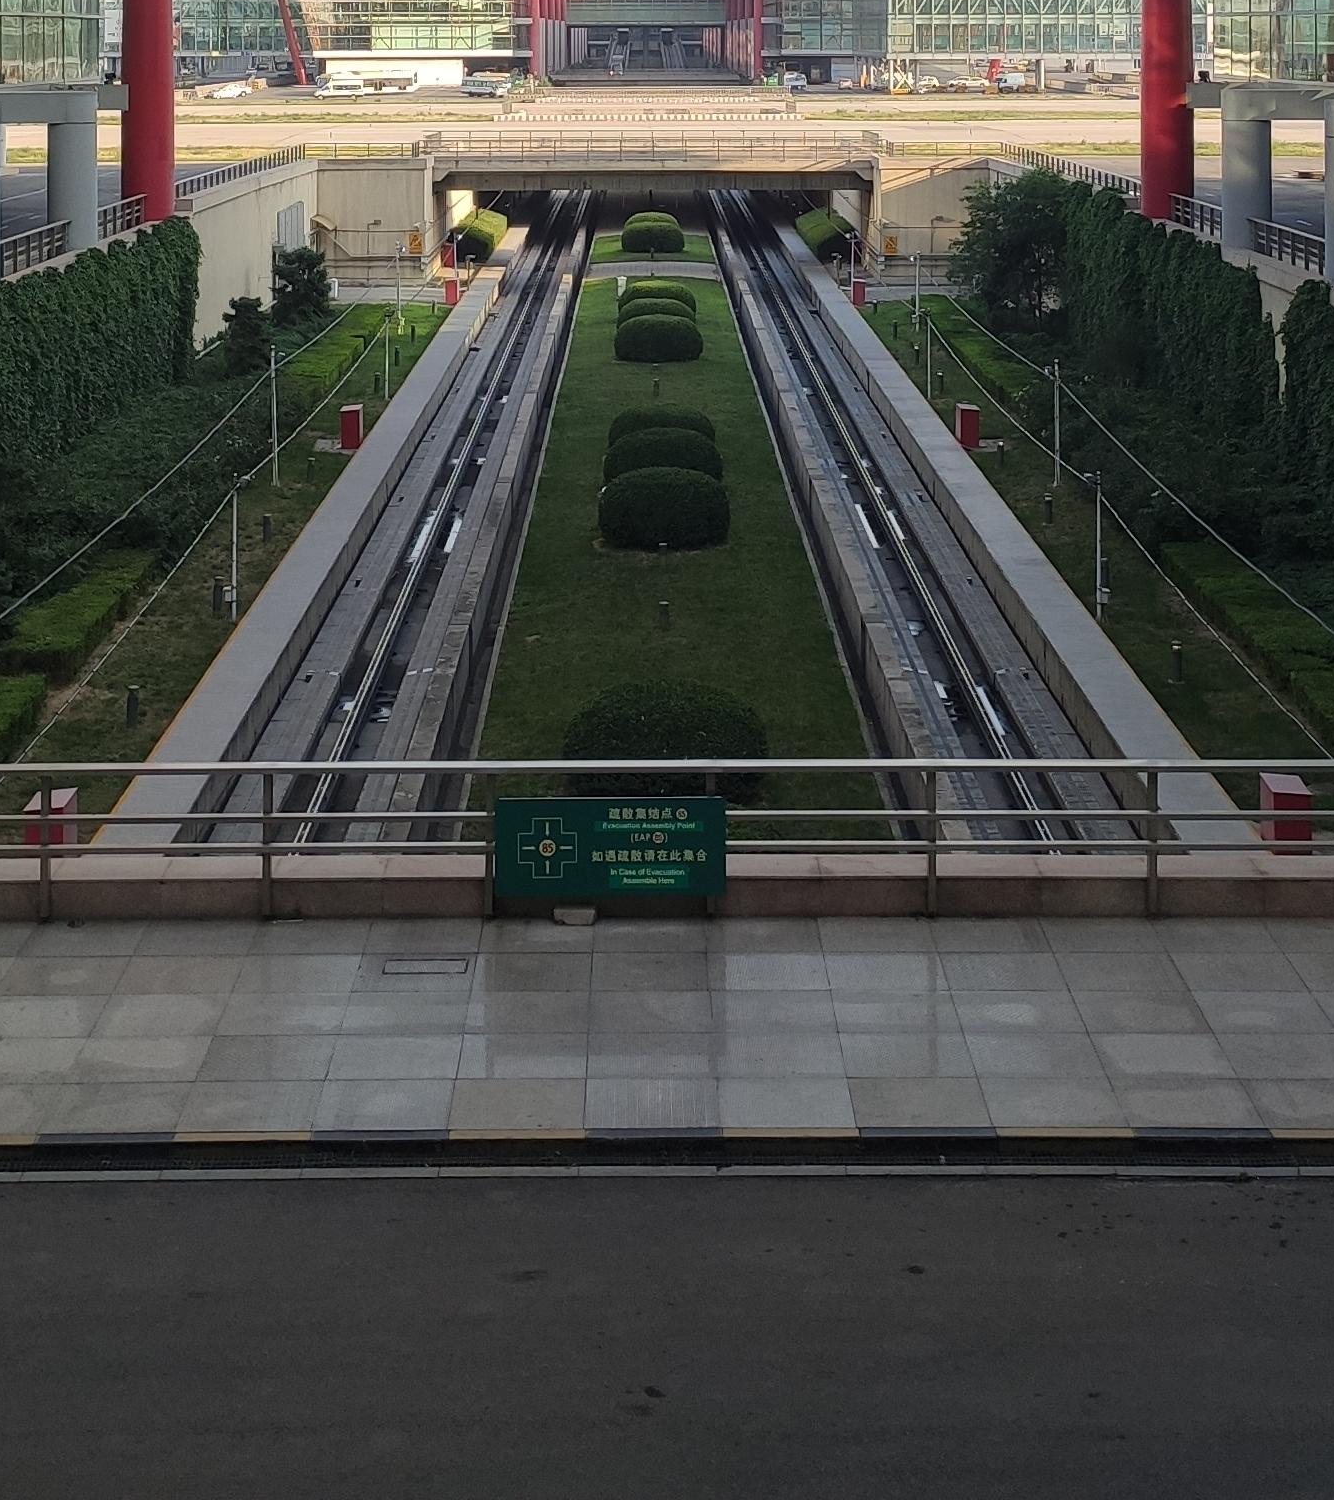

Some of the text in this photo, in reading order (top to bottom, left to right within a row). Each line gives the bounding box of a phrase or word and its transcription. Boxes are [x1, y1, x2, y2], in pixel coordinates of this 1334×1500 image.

[608, 808, 672, 819] 疏散集结点
[641, 822, 675, 831] Assembly
[542, 843, 554, 853] 85
[592, 849, 707, 861] 如遇疏散请在此集合
[610, 868, 685, 876] In Case of Evacuation
